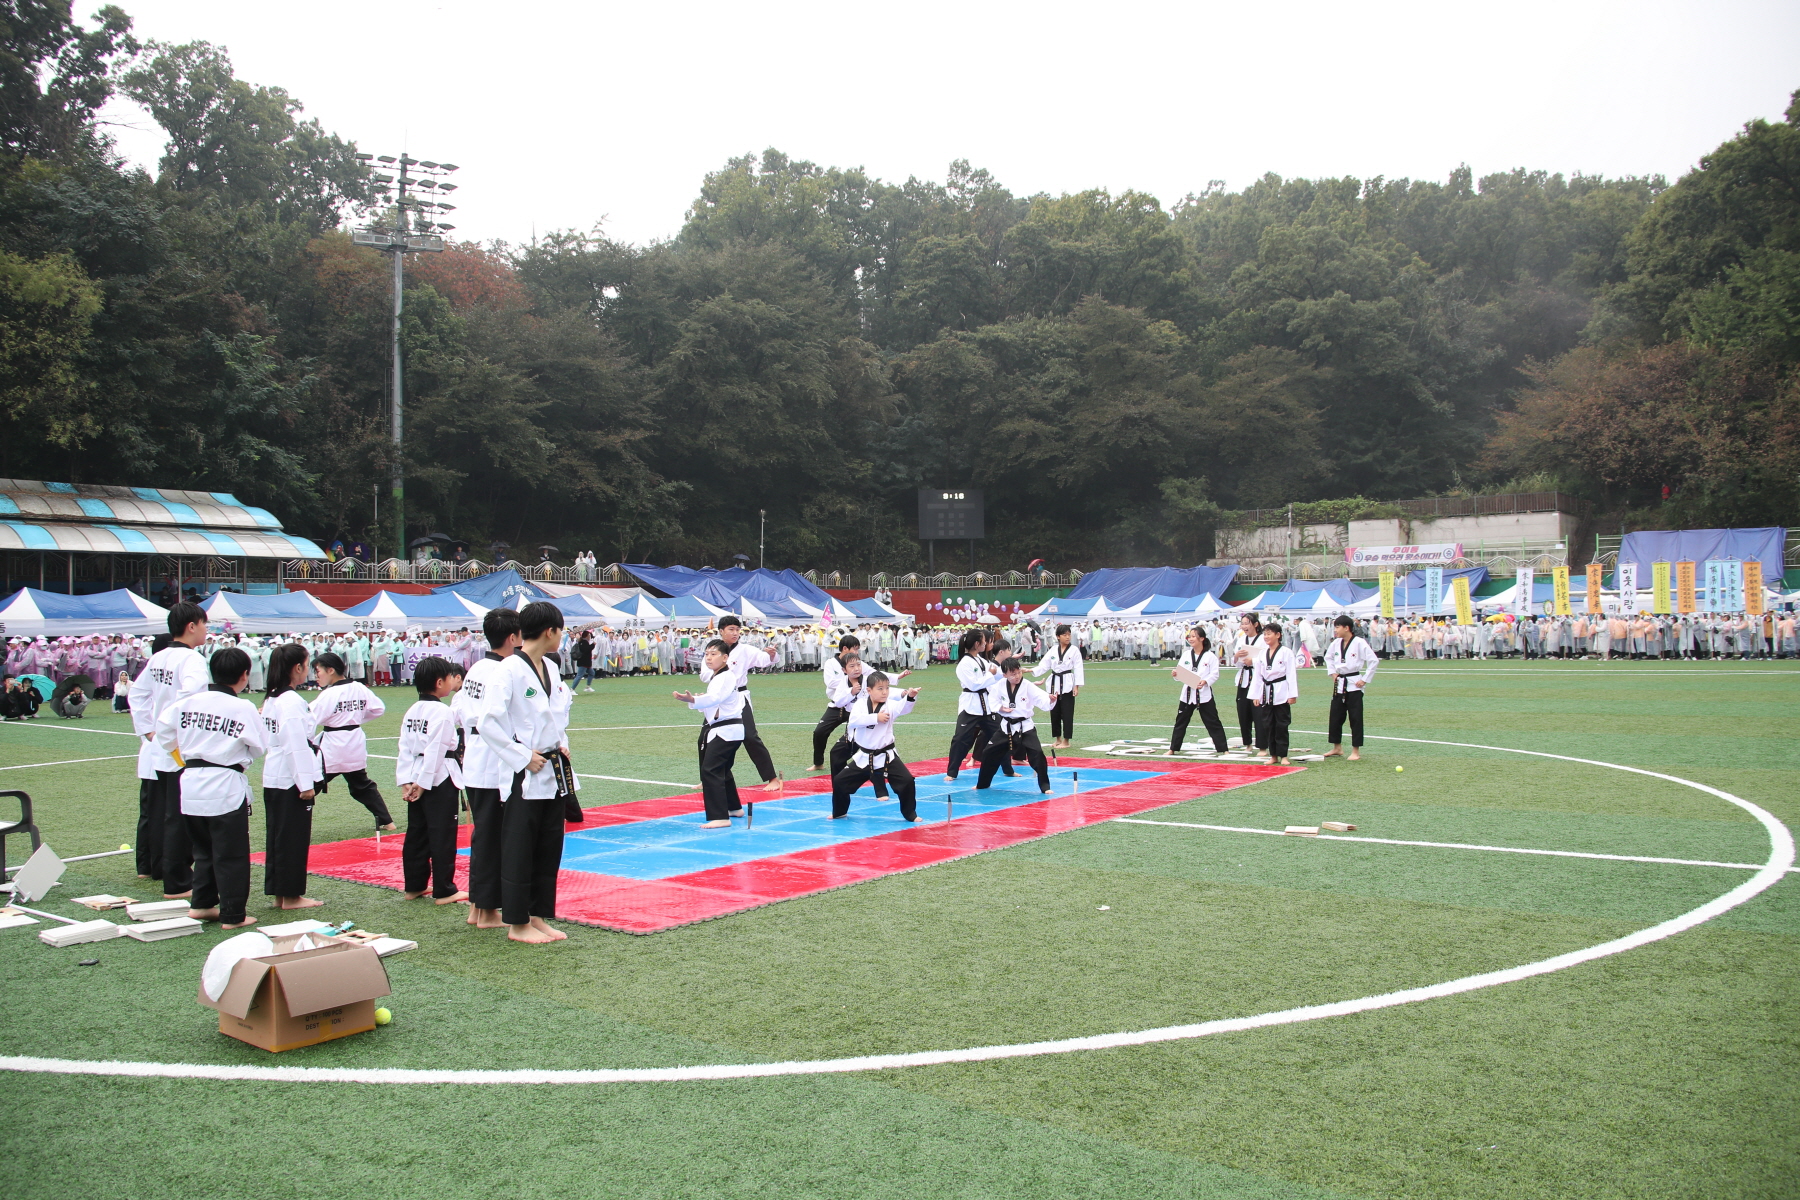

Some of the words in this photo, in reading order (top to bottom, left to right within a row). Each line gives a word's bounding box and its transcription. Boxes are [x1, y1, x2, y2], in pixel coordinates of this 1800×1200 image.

[1392, 545, 1420, 553] 우이동
[1622, 568, 1634, 610] 이웃사랑
[353, 620, 384, 630] 수유3동
[180, 711, 246, 739] 강북구태권도시범단
